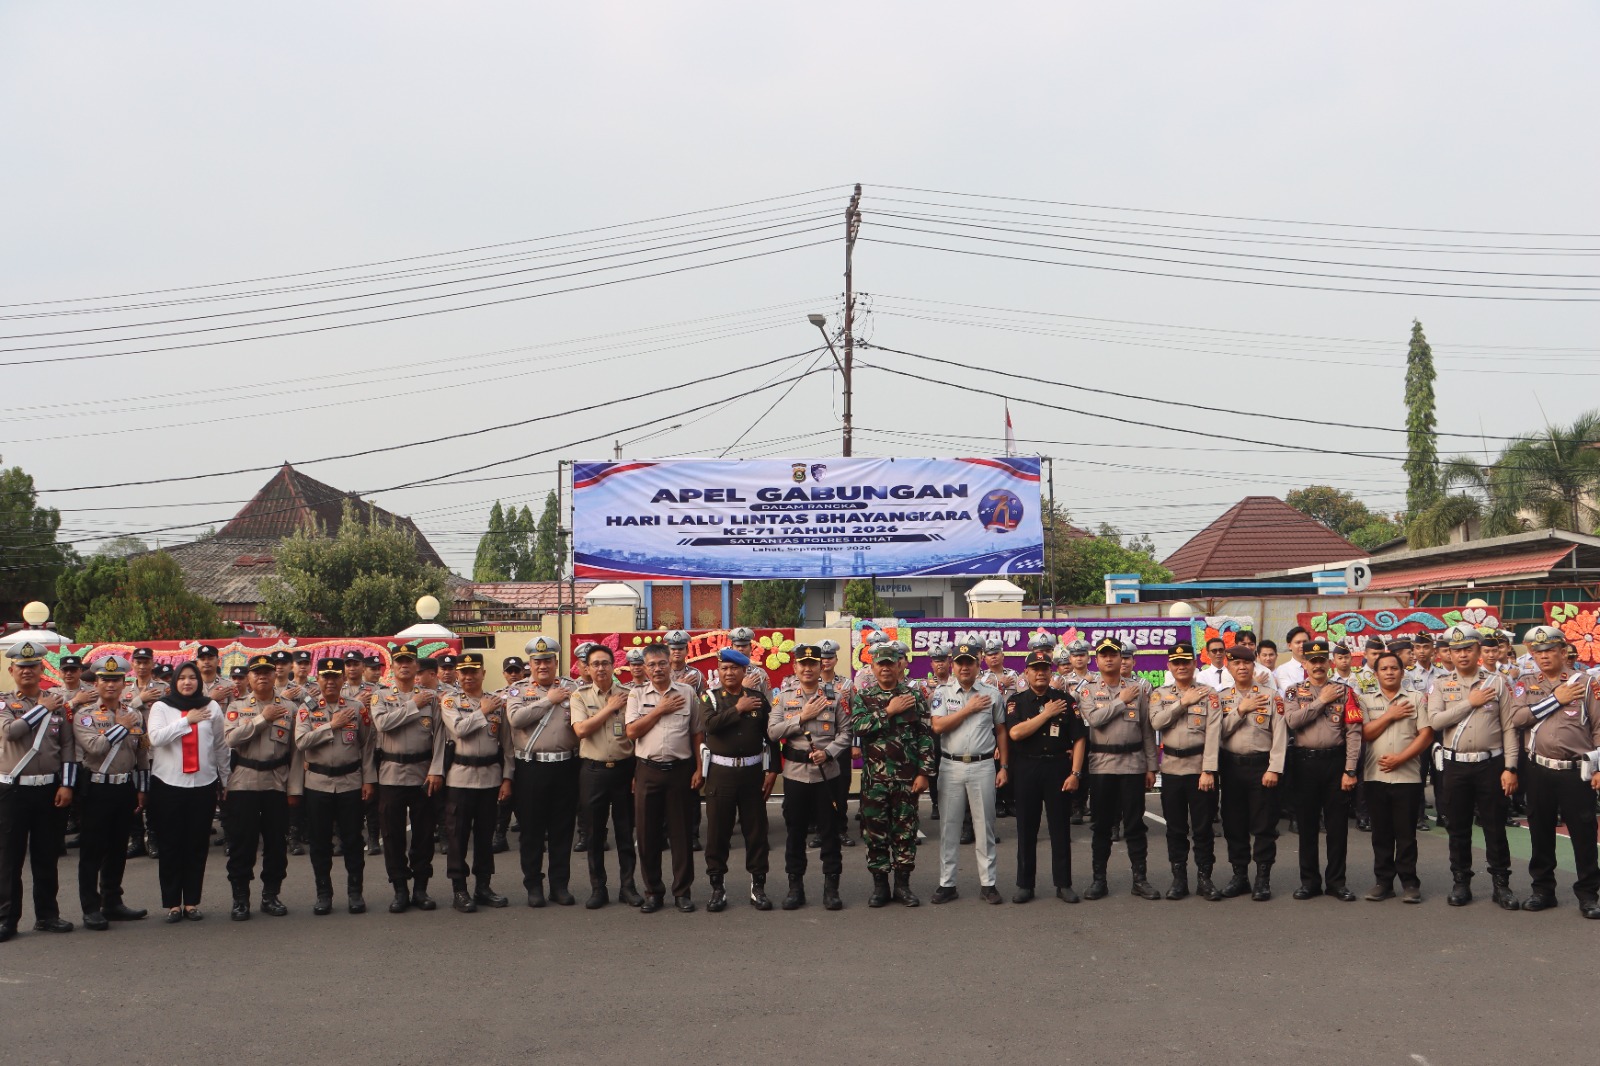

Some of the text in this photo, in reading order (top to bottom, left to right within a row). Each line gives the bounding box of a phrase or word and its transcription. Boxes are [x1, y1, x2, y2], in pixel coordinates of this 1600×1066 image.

[650, 484, 968, 503] APEL GABUNGAN
[606, 511, 972, 526] HARI LALU LINTAS BHAYANGKARA
[723, 525, 898, 536] KE-71 TAHUN 2026
[1354, 566, 1365, 586] P
[875, 584, 912, 592] BAPPEDA
